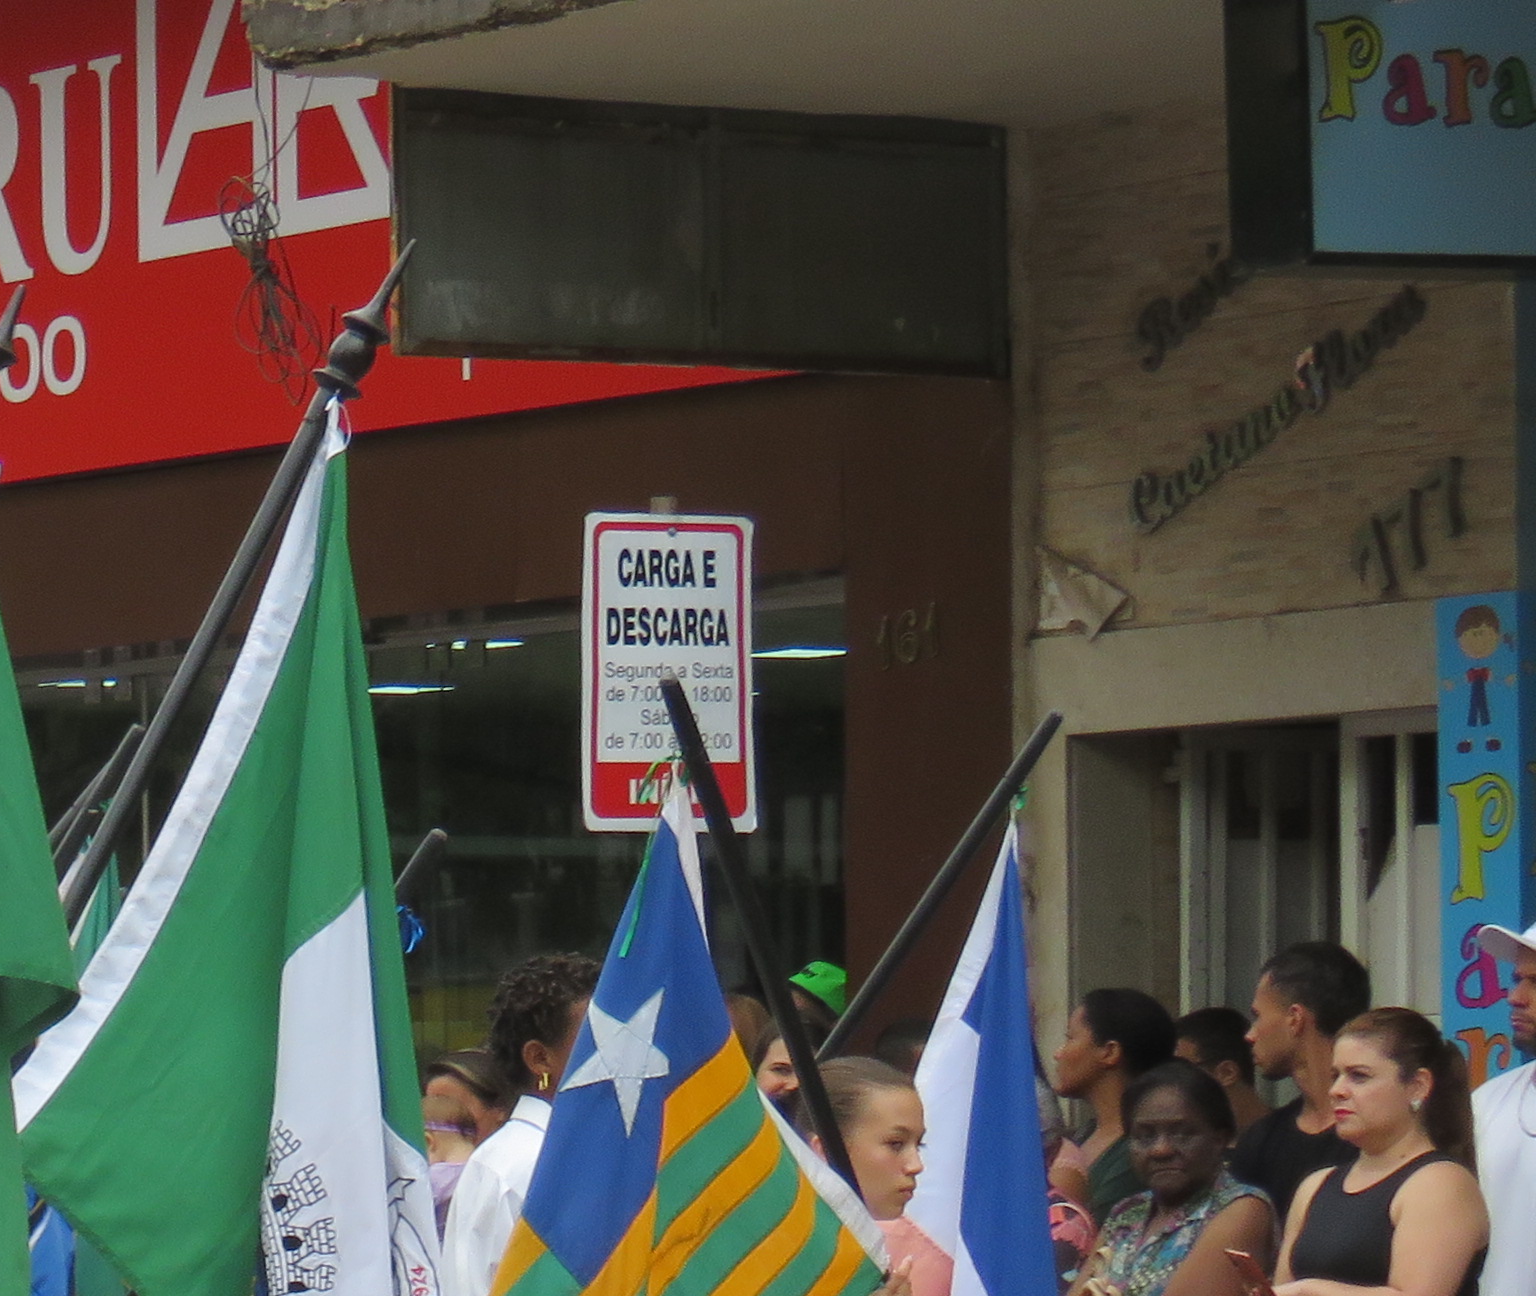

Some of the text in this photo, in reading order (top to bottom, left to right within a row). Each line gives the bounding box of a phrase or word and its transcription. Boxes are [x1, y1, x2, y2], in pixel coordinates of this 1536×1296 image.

[618, 548, 717, 588] CARGA E
[606, 607, 731, 647] DESCARGA
[692, 662, 734, 680] Sexta
[606, 686, 733, 703] de 7:00 18:00
[605, 732, 624, 749] de
[629, 732, 664, 749] 7:00
